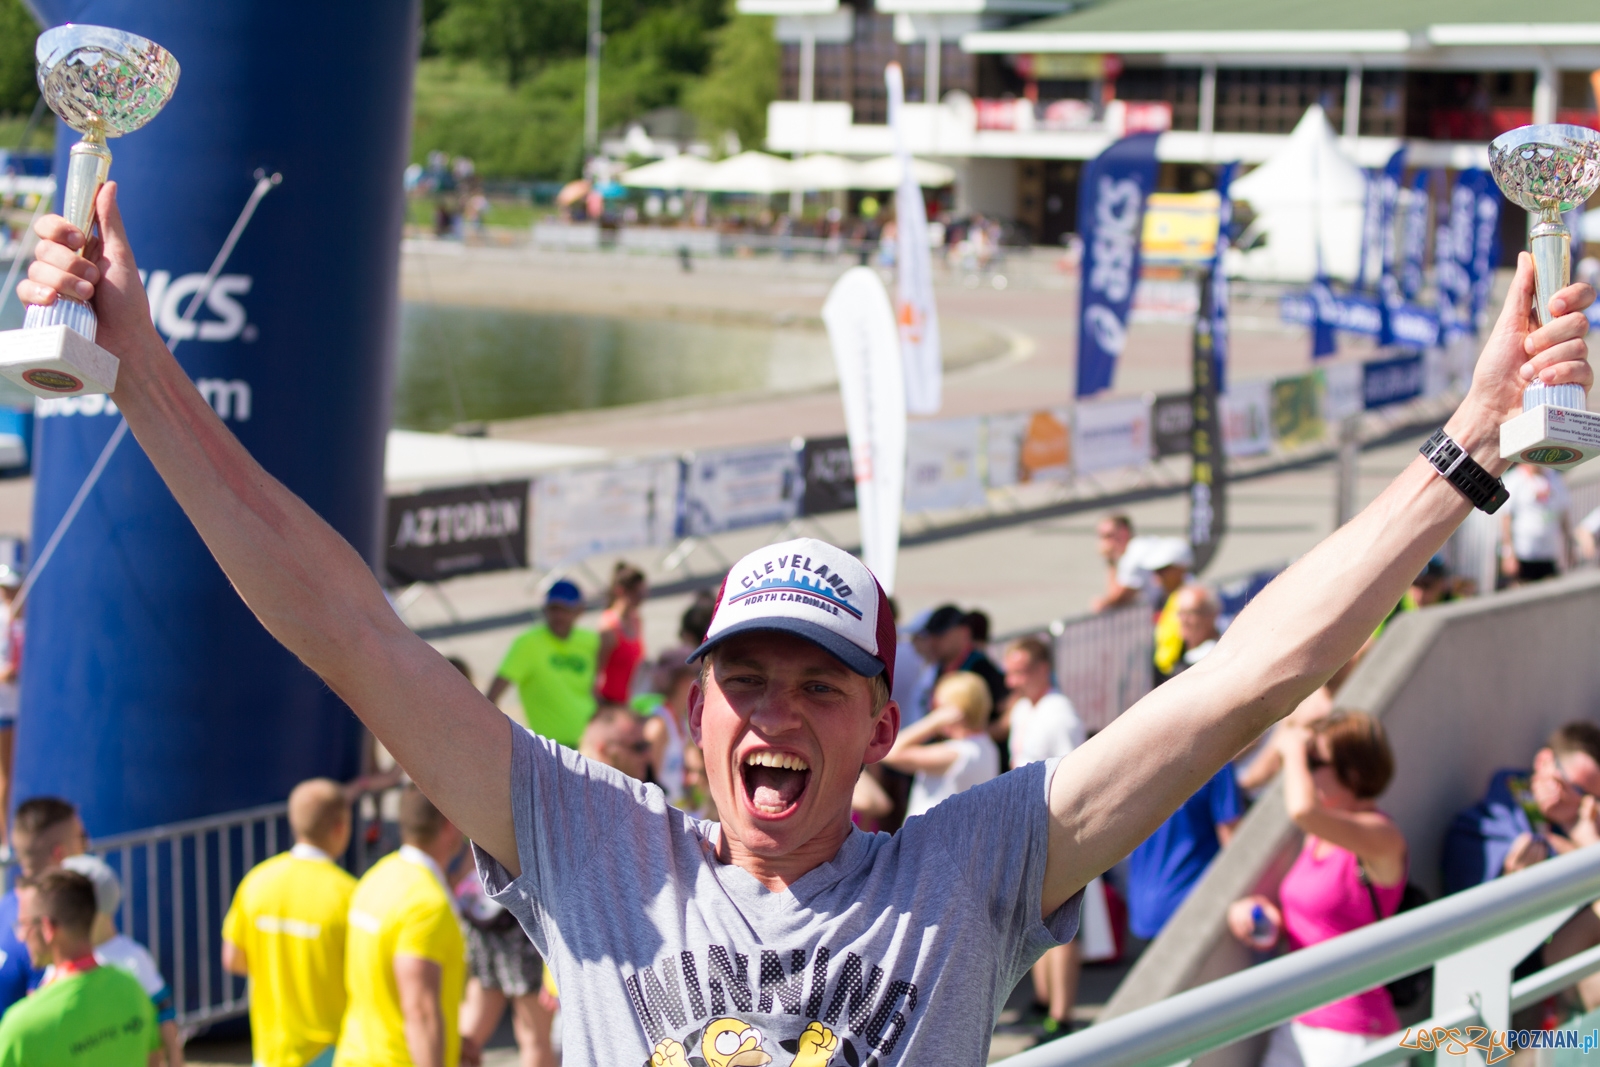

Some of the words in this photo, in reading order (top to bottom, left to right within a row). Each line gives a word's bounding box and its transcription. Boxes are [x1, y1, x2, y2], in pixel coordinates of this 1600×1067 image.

[740, 554, 853, 598] CLEVELAND
[744, 593, 777, 606] NORTH
[780, 593, 839, 616] CARDINALS
[626, 944, 918, 1056] WINNING
